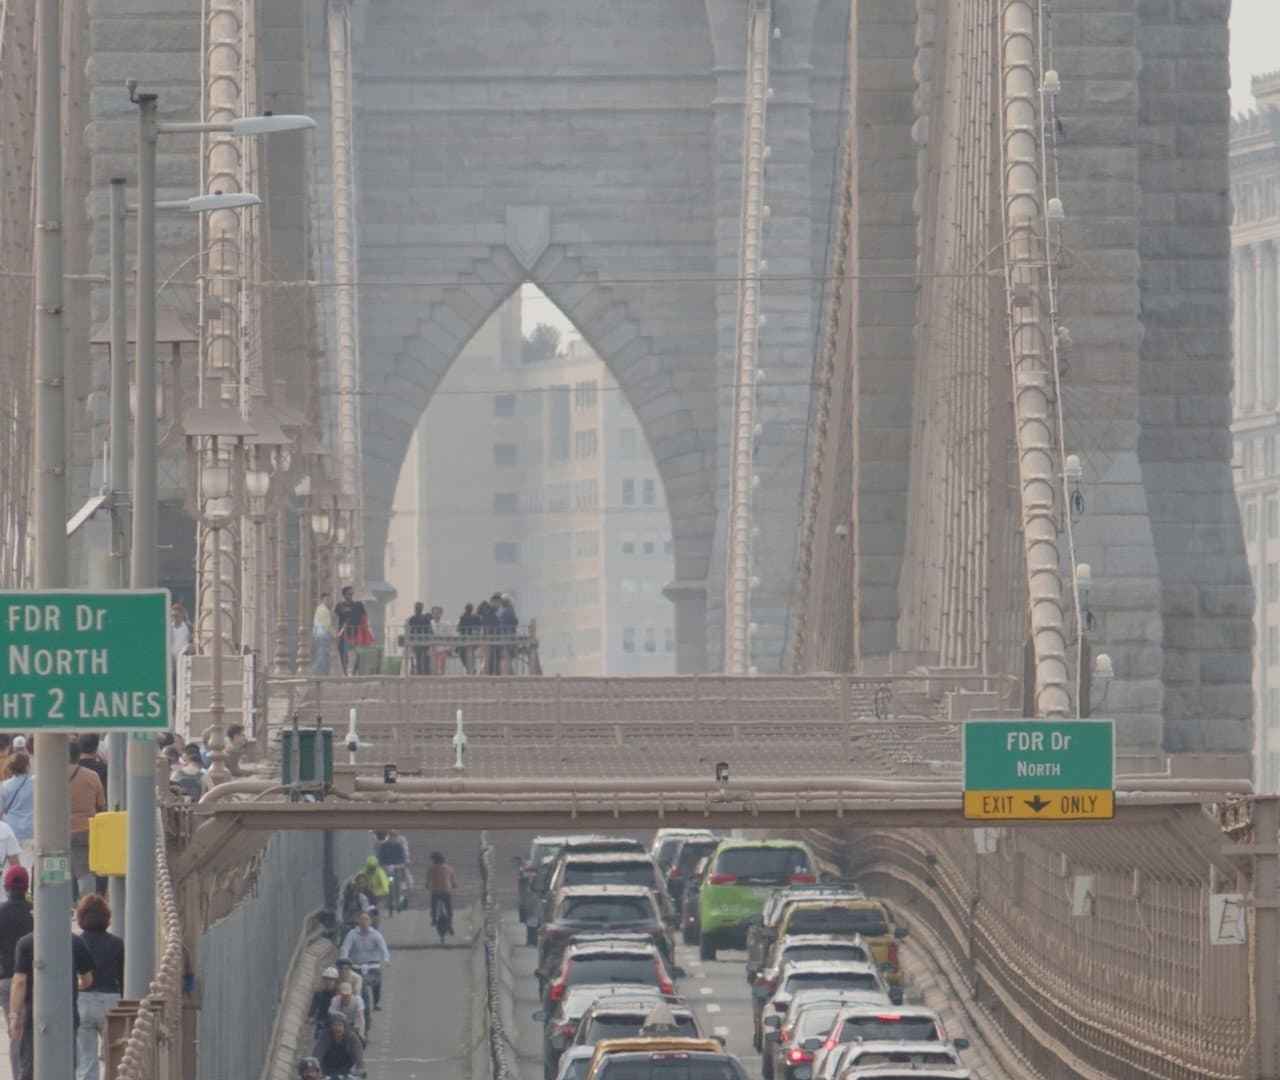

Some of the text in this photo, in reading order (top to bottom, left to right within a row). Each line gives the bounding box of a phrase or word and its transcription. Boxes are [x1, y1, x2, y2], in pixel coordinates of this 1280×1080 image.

[8, 605, 107, 632] FDR Dr
[47, 688, 64, 719] 2
[79, 690, 161, 719] LANES
[1007, 732, 1071, 751] FDR Dr
[982, 795, 1097, 814] EXIT ONLY
